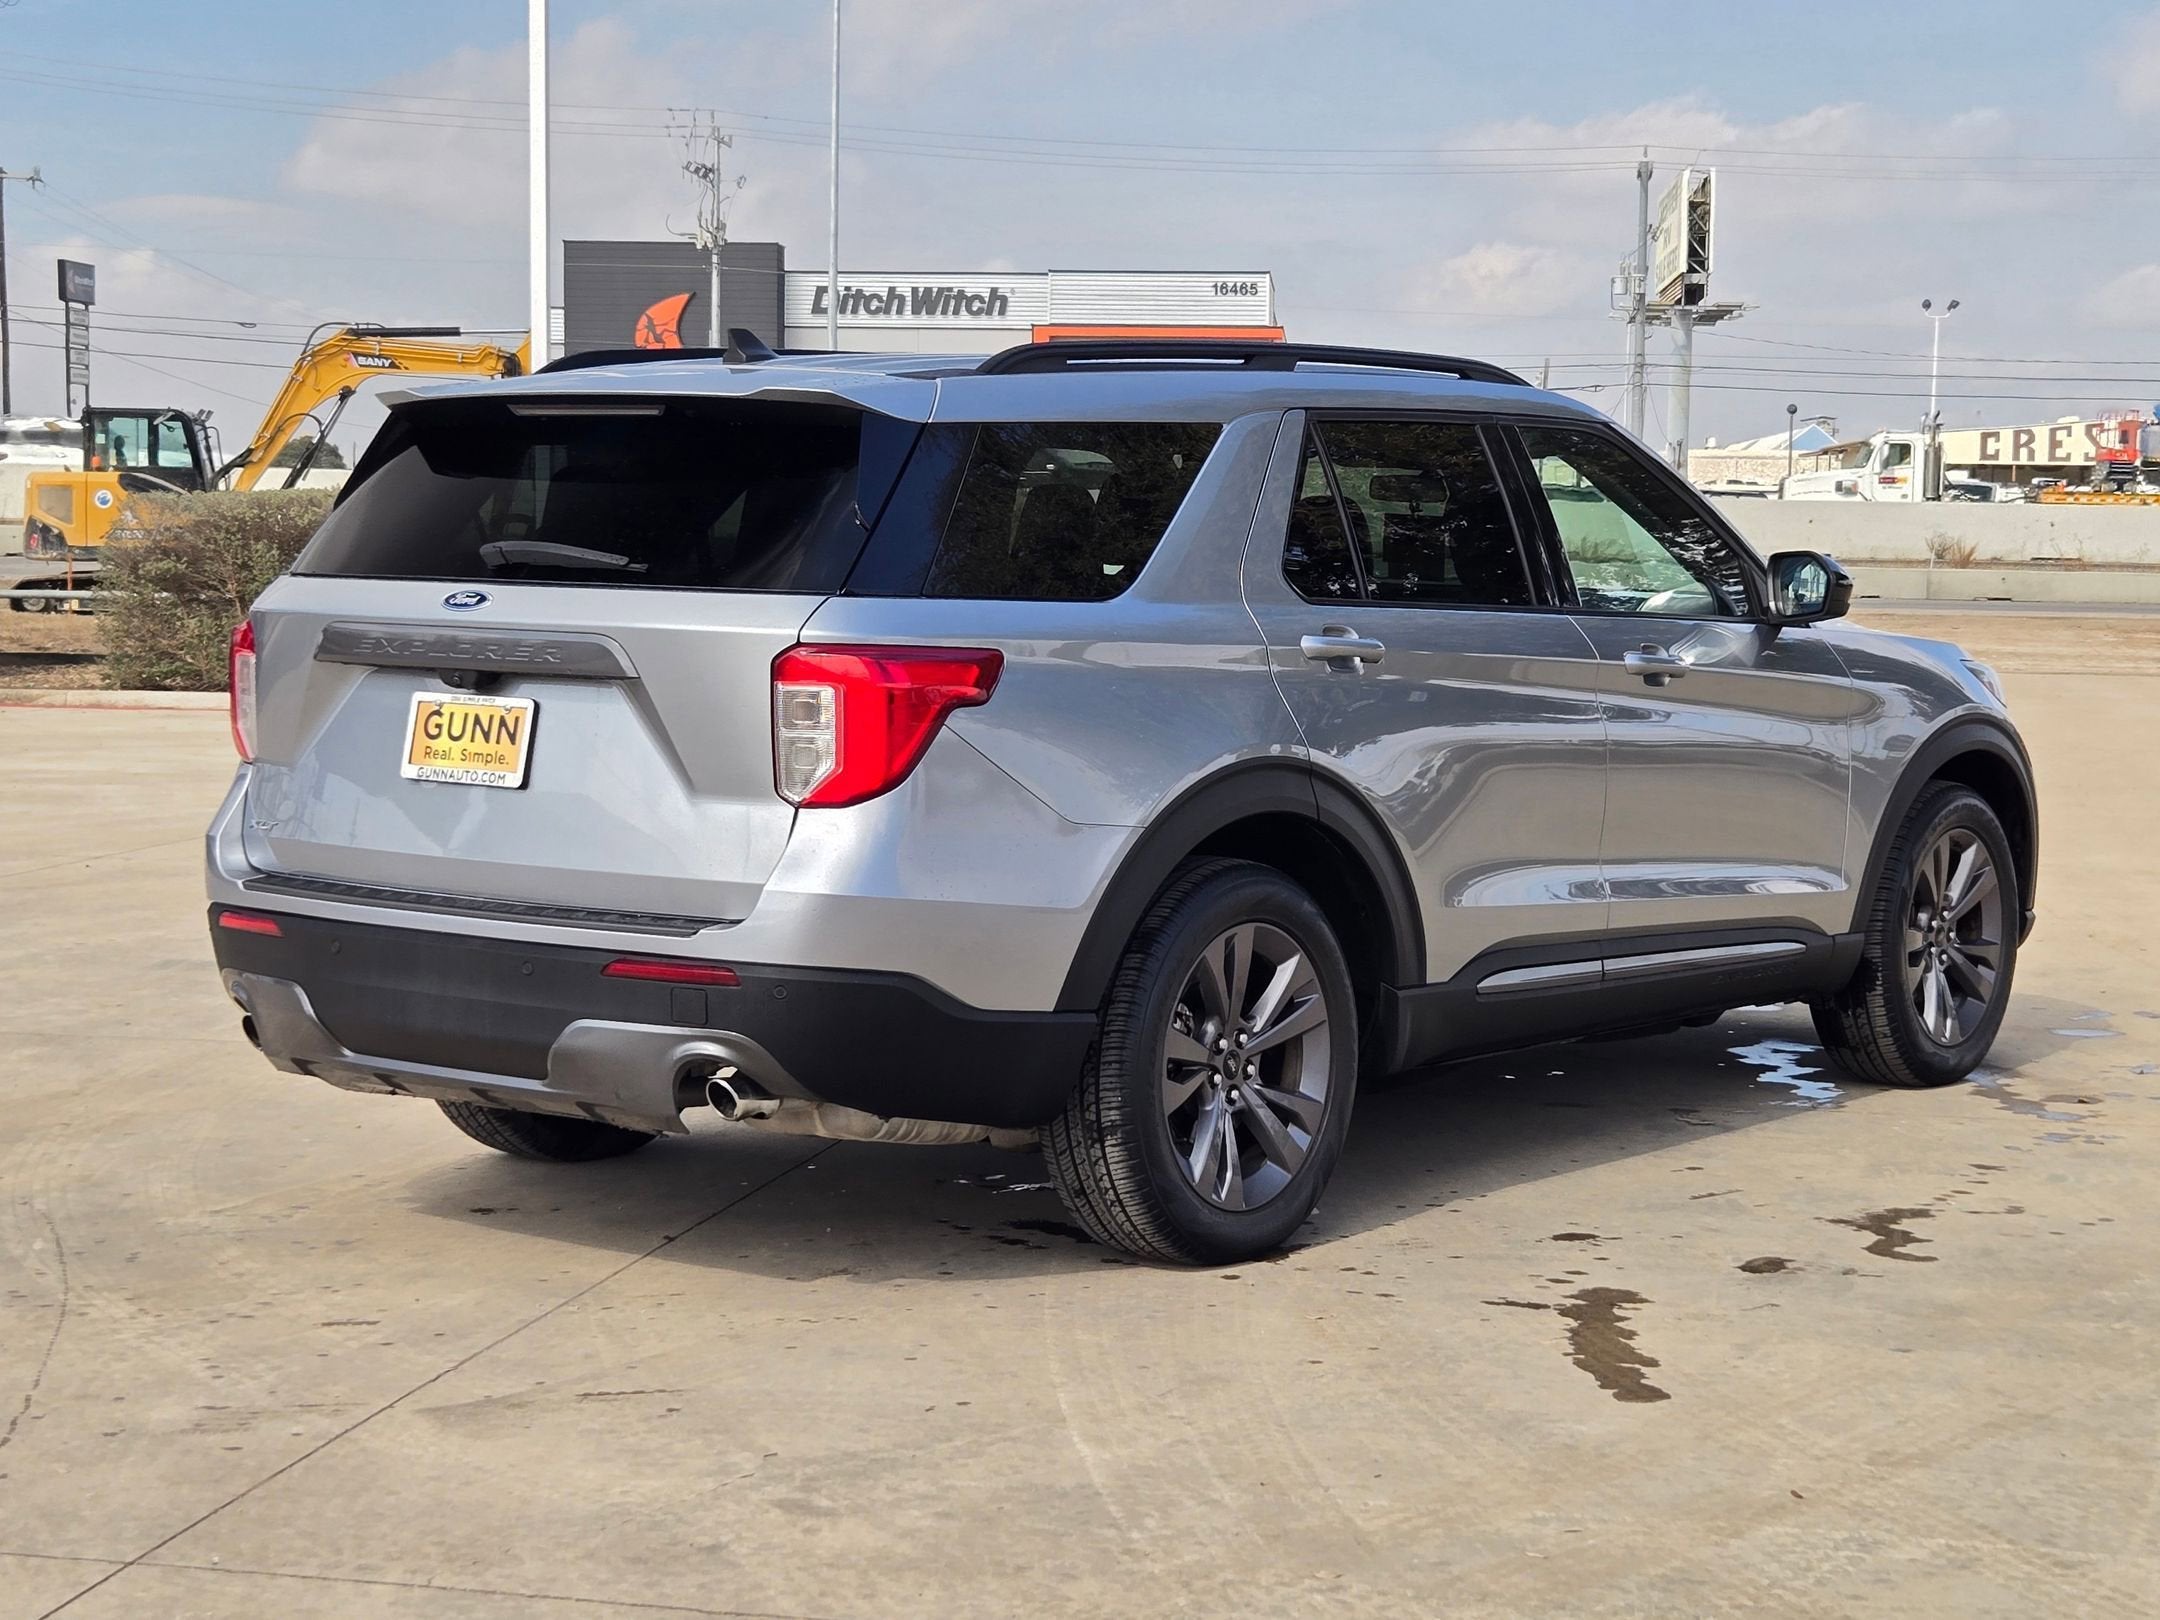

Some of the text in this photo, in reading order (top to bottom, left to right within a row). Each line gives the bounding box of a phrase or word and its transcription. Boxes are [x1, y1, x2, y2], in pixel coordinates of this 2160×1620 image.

[1212, 282, 1258, 296] 16465
[811, 286, 1009, 316] Ditch Witch
[357, 356, 392, 367] SANY
[353, 639, 561, 663] EXPLORER
[423, 709, 520, 746] GUNN
[424, 746, 509, 767] Real. Simple.
[416, 766, 507, 784] GUNNAUTO.COM
